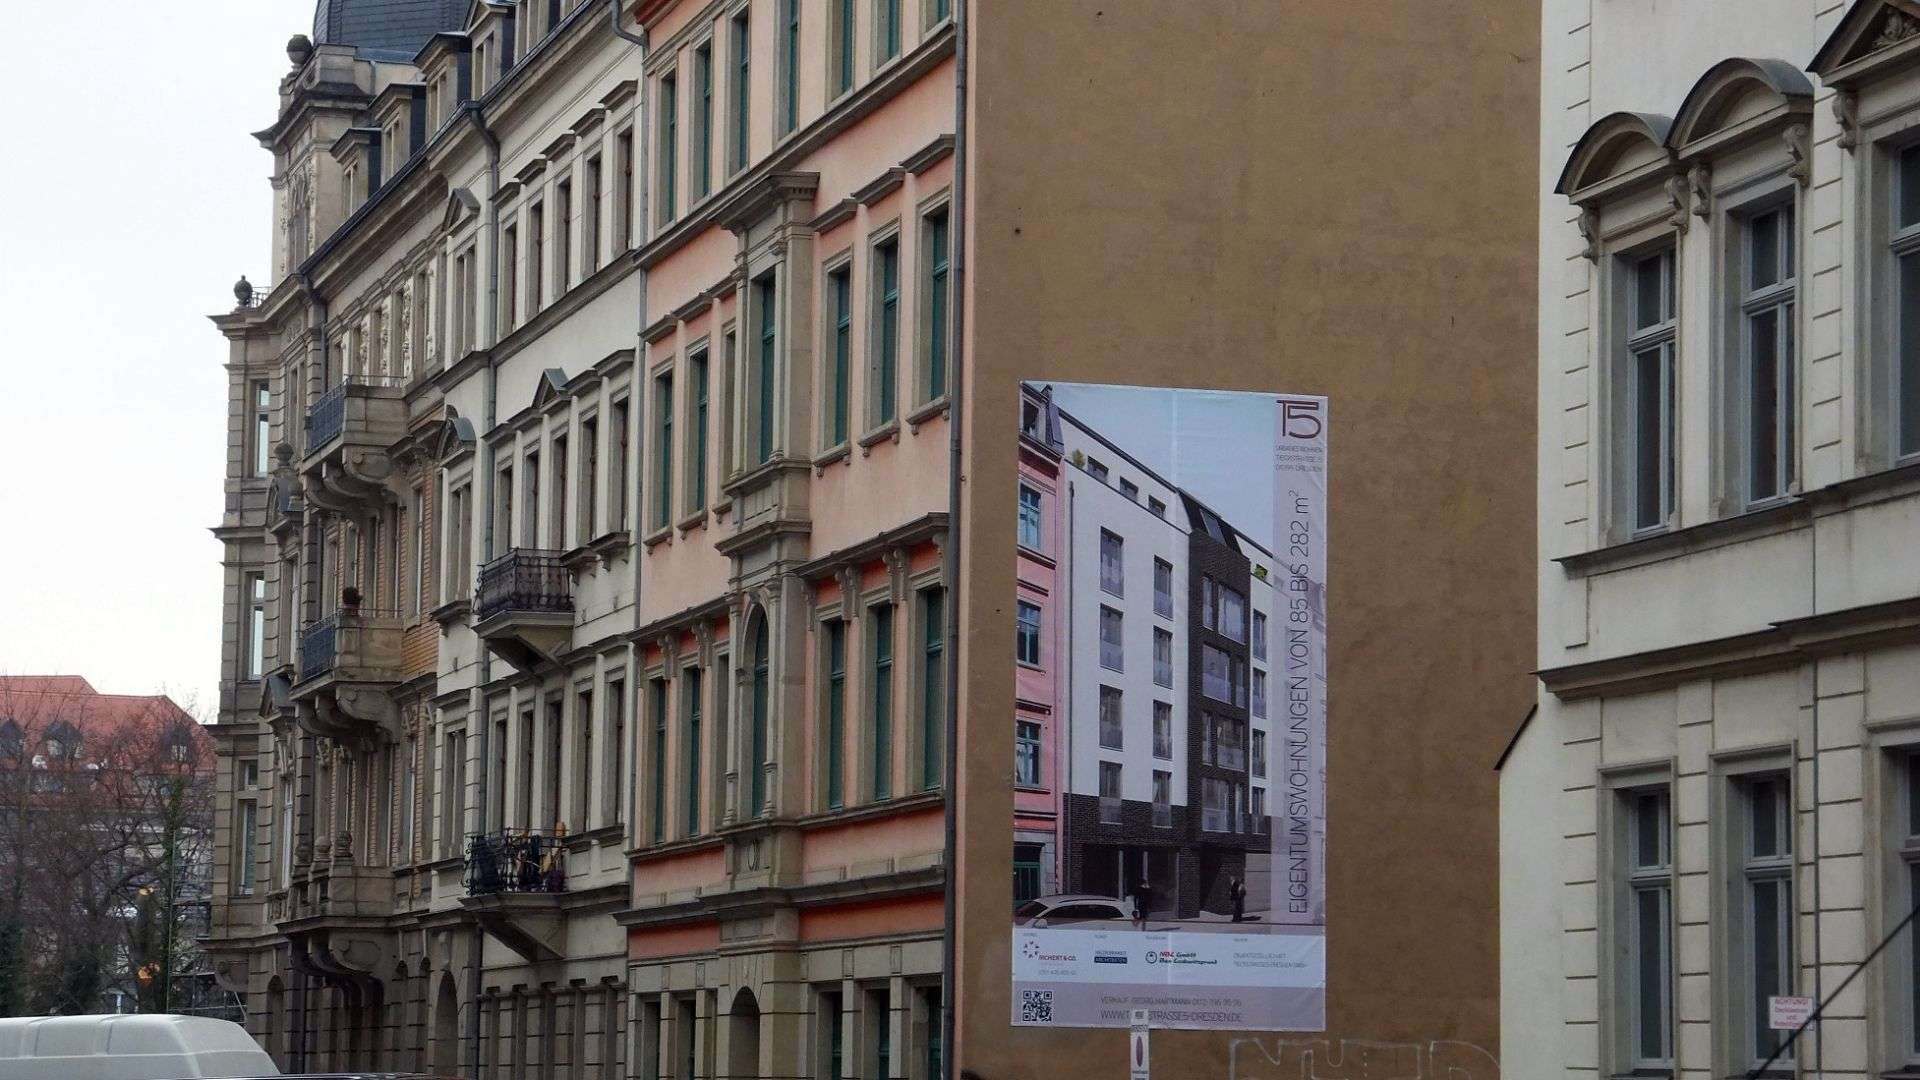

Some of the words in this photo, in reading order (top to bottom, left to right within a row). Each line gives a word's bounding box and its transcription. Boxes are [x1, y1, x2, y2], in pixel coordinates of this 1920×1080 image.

[1290, 520, 1309, 557] 282
[1290, 563, 1309, 592] BIS
[1290, 598, 1309, 623] 85
[1289, 629, 1309, 670] VON
[1289, 676, 1309, 914] EIGENTUMSWOHNUNGEN
